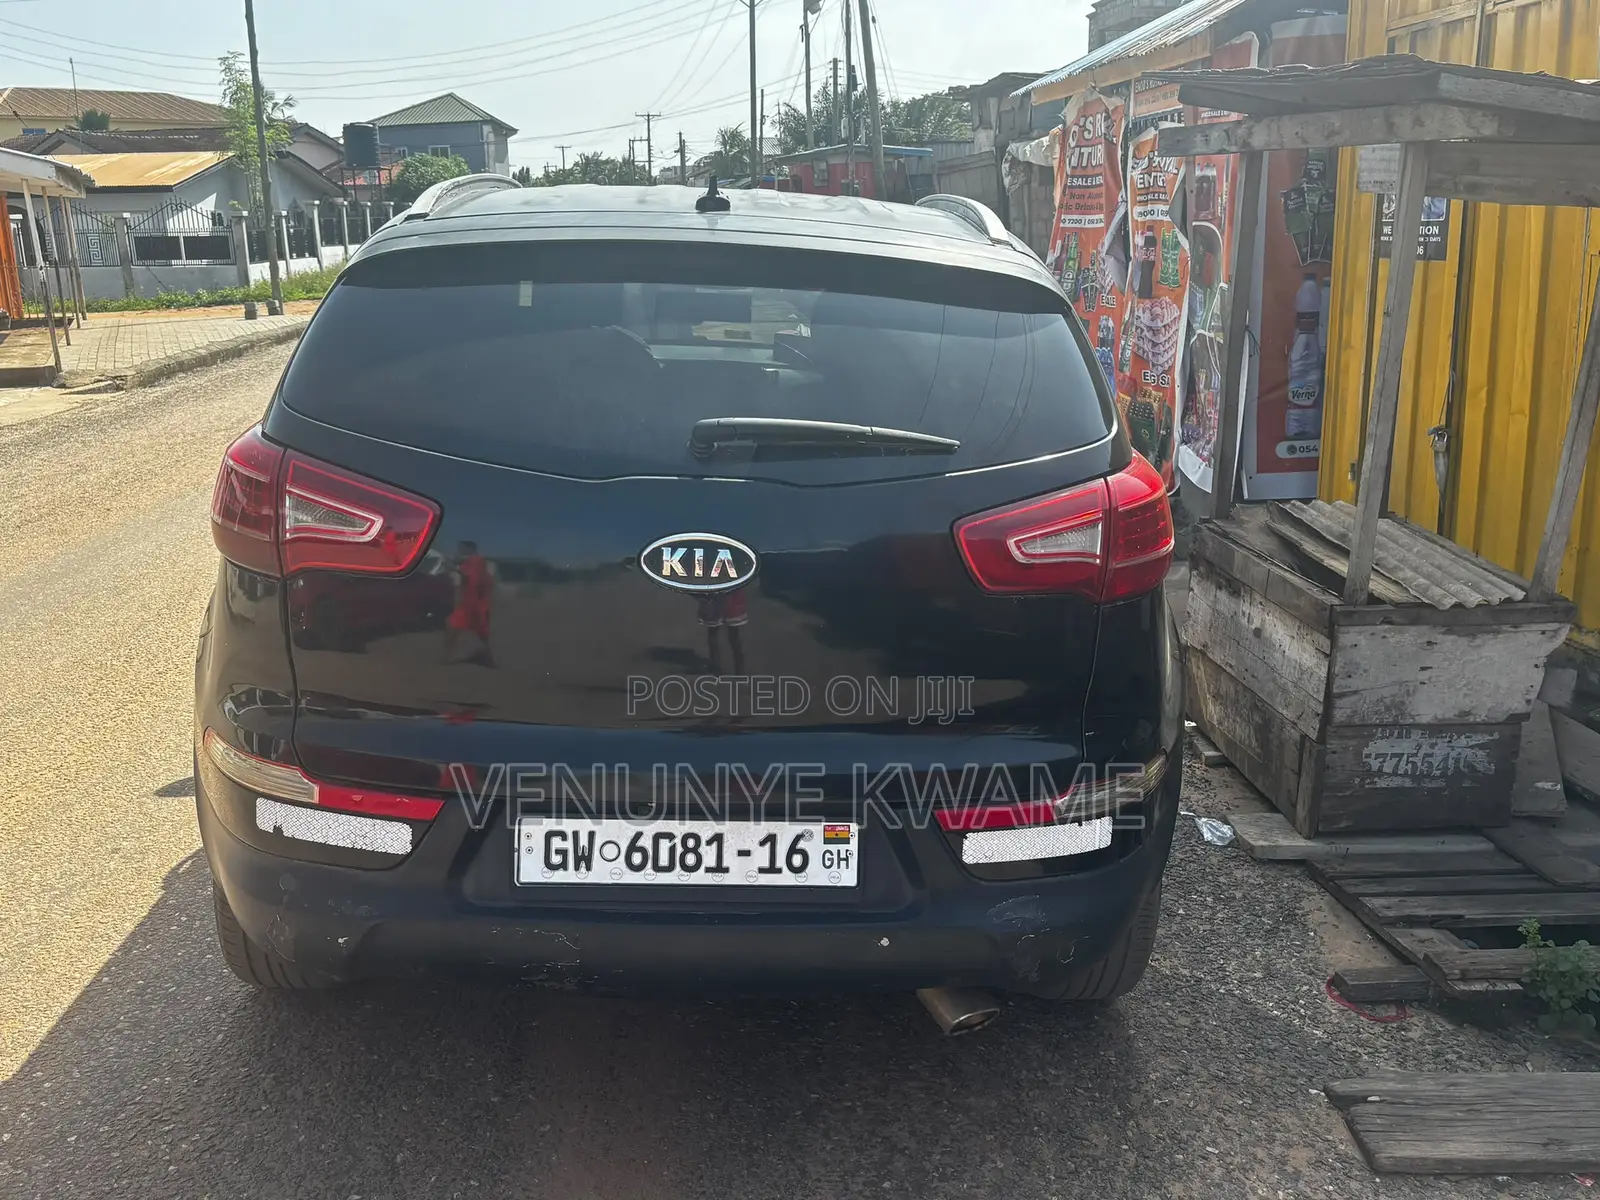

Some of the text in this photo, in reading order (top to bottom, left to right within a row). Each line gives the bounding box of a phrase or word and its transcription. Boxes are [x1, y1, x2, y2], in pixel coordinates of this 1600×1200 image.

[1292, 390, 1316, 400] Verna
[661, 547, 738, 578] KIA
[544, 830, 810, 874] GW 6081-16
[822, 849, 850, 869] GH
